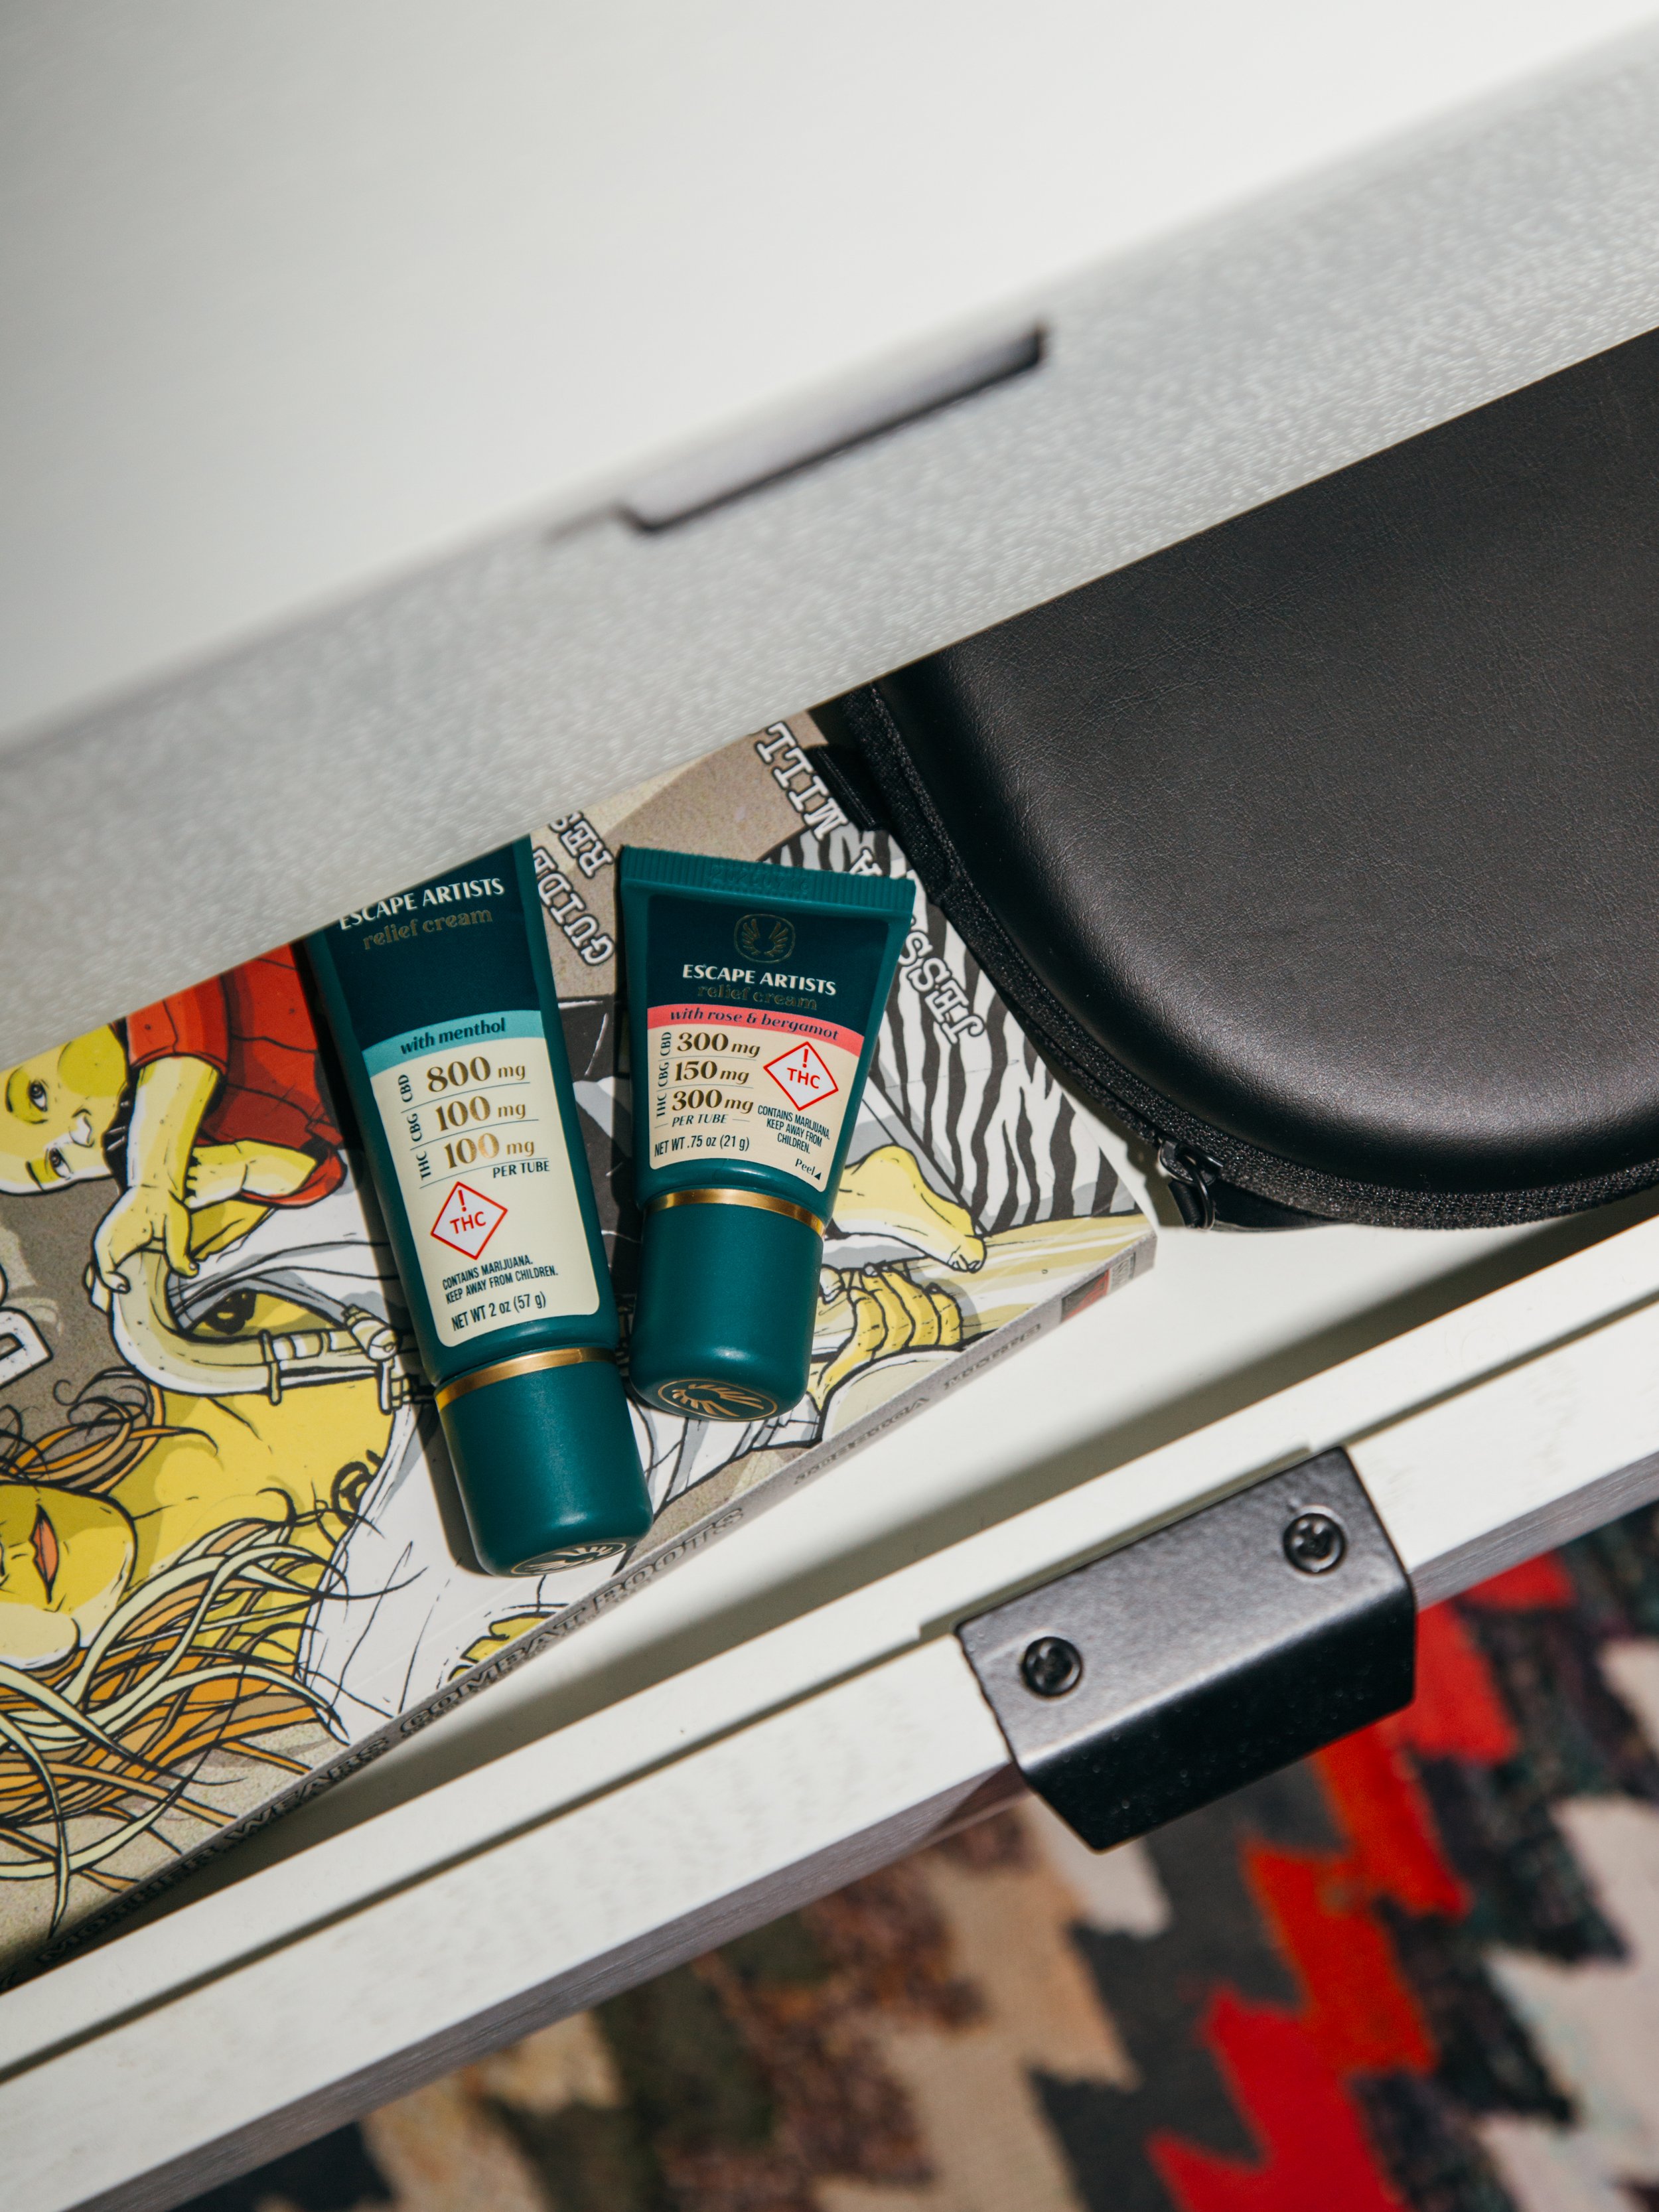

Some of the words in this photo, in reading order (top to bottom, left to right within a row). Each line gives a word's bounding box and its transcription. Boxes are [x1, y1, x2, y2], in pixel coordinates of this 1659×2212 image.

[339, 893, 417, 930] ESCAPE
[423, 878, 505, 907] ARTISTS
[363, 919, 419, 950] relief
[422, 909, 493, 933] cream
[682, 964, 756, 984] ESCAPE
[759, 972, 837, 996] ARTISTS
[697, 984, 751, 1001] relief
[753, 992, 818, 1010] cream
[401, 1032, 435, 1054] with
[439, 1017, 506, 1043] menthol
[670, 1007, 703, 1021] with
[707, 1011, 743, 1023] rose
[746, 1013, 758, 1024] &
[761, 1013, 839, 1041] bergamot
[660, 1031, 672, 1056] CBD
[677, 1032, 729, 1051] 300
[731, 1043, 761, 1058] mg
[427, 1057, 491, 1092] 800
[498, 1065, 526, 1080] mg
[658, 1062, 669, 1087] CBG
[675, 1061, 717, 1081] 150
[719, 1070, 749, 1085] mg
[787, 1067, 820, 1089] THC
[397, 1074, 413, 1102] CBD
[672, 1089, 722, 1110] 300
[724, 1098, 754, 1114] mg
[435, 1096, 490, 1132] 100
[498, 1104, 526, 1119] mg
[656, 1093, 667, 1119] THC
[672, 1115, 694, 1127] PER
[697, 1114, 729, 1124] TUBE
[407, 1113, 423, 1142] CBG
[758, 1105, 793, 1122] CONTAINS
[795, 1114, 830, 1140] MARIJUANA.
[766, 1118, 784, 1130] KEEP
[786, 1124, 804, 1138] AWAY
[805, 1132, 822, 1147] FROM
[444, 1133, 500, 1169] 100
[506, 1141, 535, 1157] mg
[654, 1140, 669, 1157] NET
[672, 1137, 685, 1151] WT
[687, 1135, 703, 1148] .75
[706, 1136, 717, 1147] oz
[720, 1134, 735, 1149] (21
[739, 1137, 750, 1151] g)
[777, 1133, 810, 1154] CHILDREN.
[416, 1151, 431, 1181] THC
[493, 1164, 517, 1179] PER
[520, 1160, 550, 1174] TUBE
[795, 1158, 815, 1175] Peel
[449, 1211, 486, 1234] THC
[443, 1268, 479, 1290] CONTAINS
[480, 1254, 533, 1276] MARIJUANA.
[445, 1289, 463, 1304] KEEP
[466, 1280, 486, 1296] AWAY
[489, 1272, 513, 1288] FROM
[515, 1265, 558, 1282] CHILDREN.
[451, 1311, 469, 1331] NET
[470, 1305, 486, 1323] WT
[488, 1303, 496, 1317] 2
[499, 1301, 511, 1314] oz
[513, 1293, 530, 1313] (57
[534, 1291, 546, 1309] g)
[223, 1736, 390, 1840] WEARS
[400, 1607, 586, 1733] COMBAT
[593, 1507, 743, 1614] BOOTS
